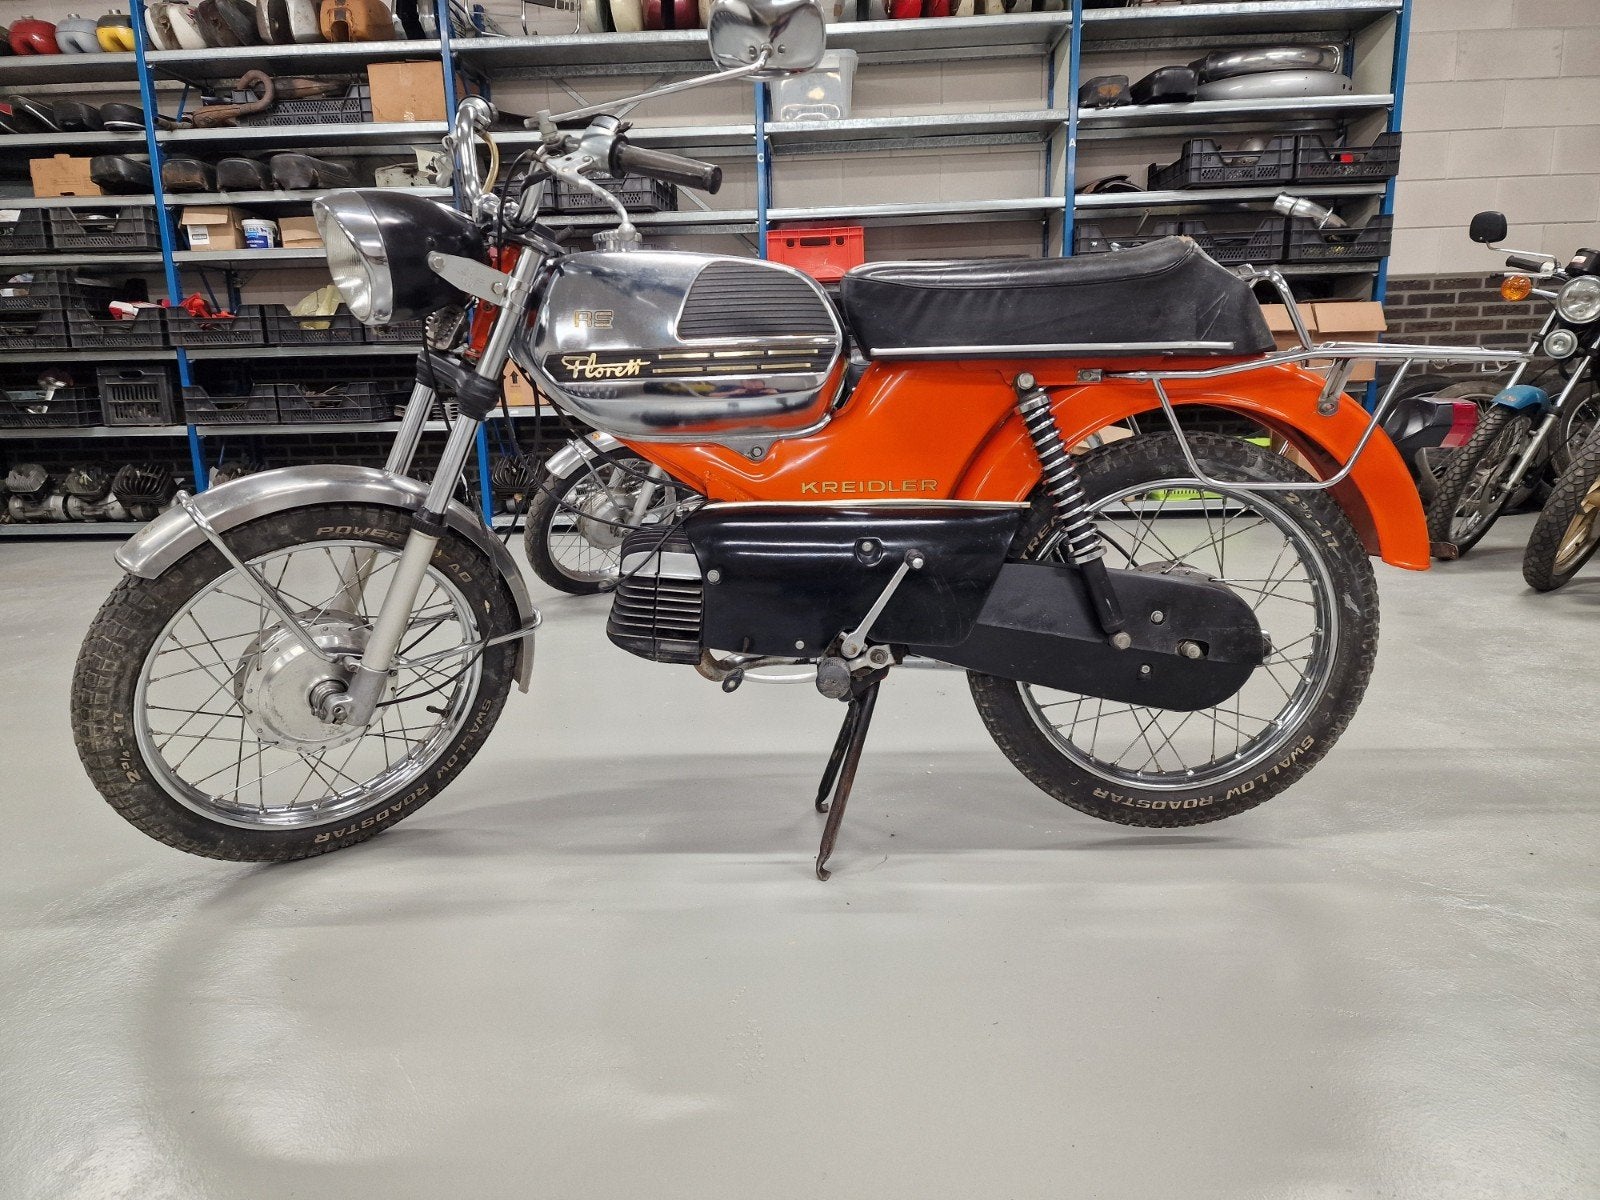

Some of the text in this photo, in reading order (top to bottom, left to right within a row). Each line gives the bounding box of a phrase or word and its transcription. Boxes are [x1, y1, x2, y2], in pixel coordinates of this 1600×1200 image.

[1069, 138, 1076, 147] A
[574, 309, 613, 329] RS
[561, 353, 651, 379] Florett
[801, 479, 938, 494] KREIDLER
[316, 526, 402, 541] POWER
[314, 699, 492, 843] SWALLOW ROADSTAR
[1092, 735, 1315, 810] SWALLOW ROADSTAR
